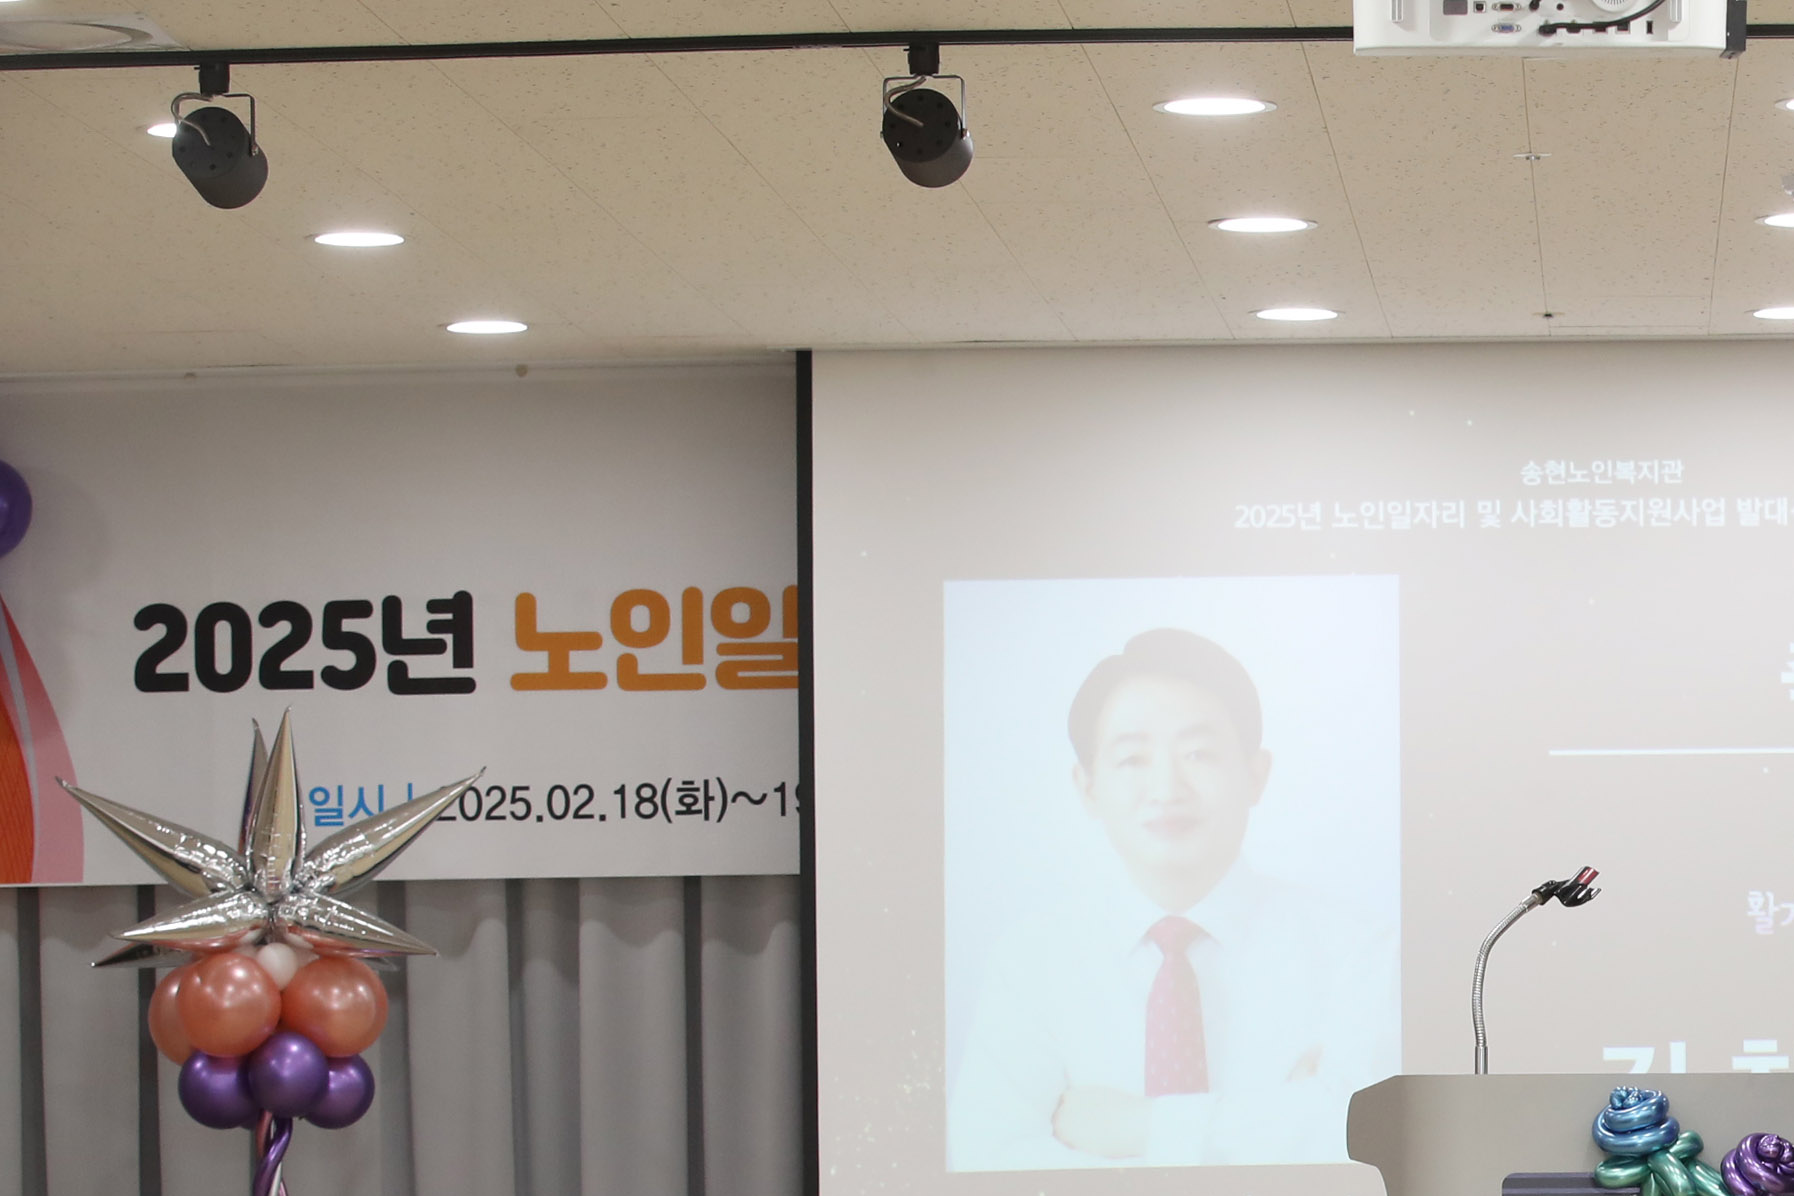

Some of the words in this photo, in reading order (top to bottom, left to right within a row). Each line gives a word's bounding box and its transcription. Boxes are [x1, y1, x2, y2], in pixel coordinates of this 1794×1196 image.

[1519, 459, 1685, 486] 송현노인복지관
[1234, 502, 1323, 531] 2025년
[1331, 500, 1465, 530] 노인일자리
[1476, 499, 1501, 529] 및
[1510, 496, 1727, 529] 사회활동지원사업
[133, 590, 477, 696] 2025년
[509, 584, 798, 692] 노인일
[308, 783, 384, 828] 일시
[434, 776, 800, 824] 025.02.18(화)~1
